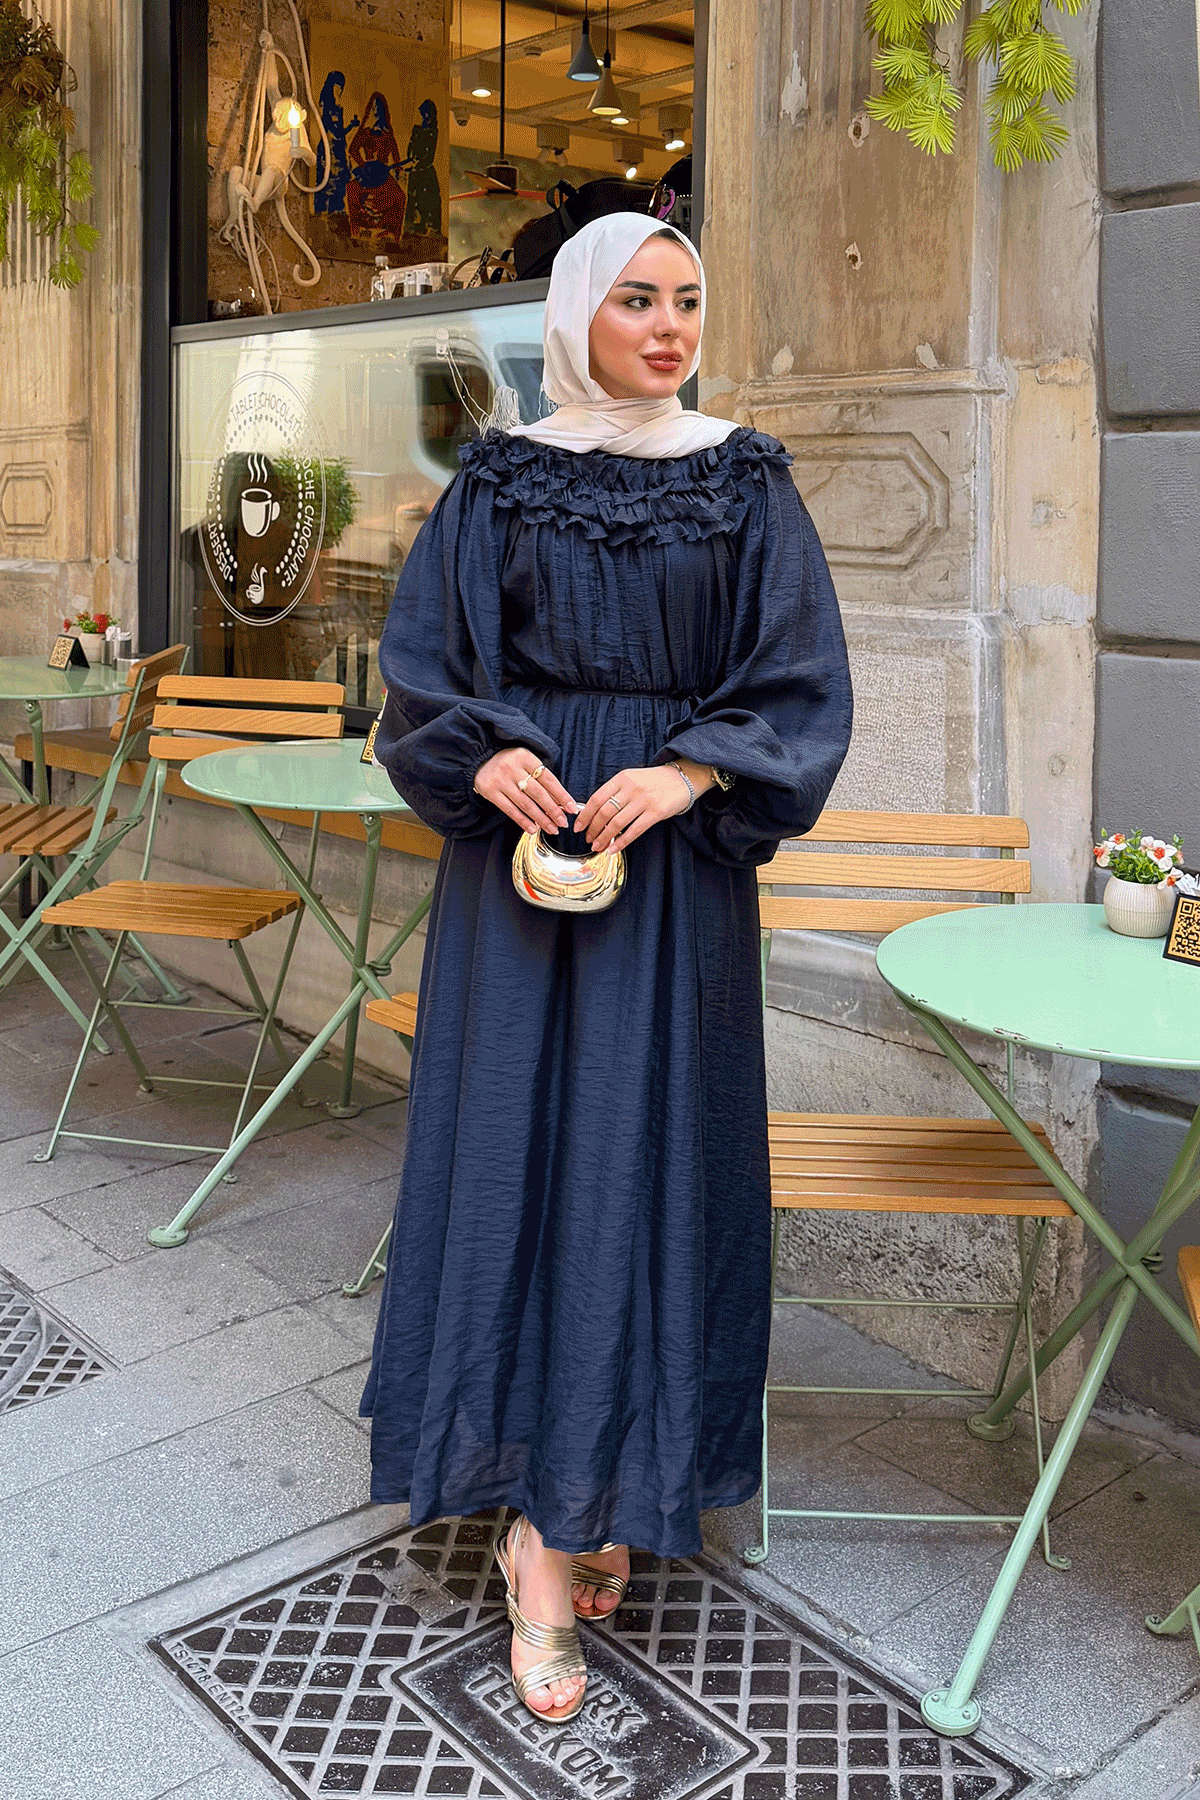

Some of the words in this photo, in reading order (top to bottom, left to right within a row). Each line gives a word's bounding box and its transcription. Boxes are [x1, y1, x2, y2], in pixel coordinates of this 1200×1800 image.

[259, 391, 303, 441] CHOCOLATE
[207, 522, 232, 580] DESSERT
[283, 504, 315, 587] CHOCOLATE
